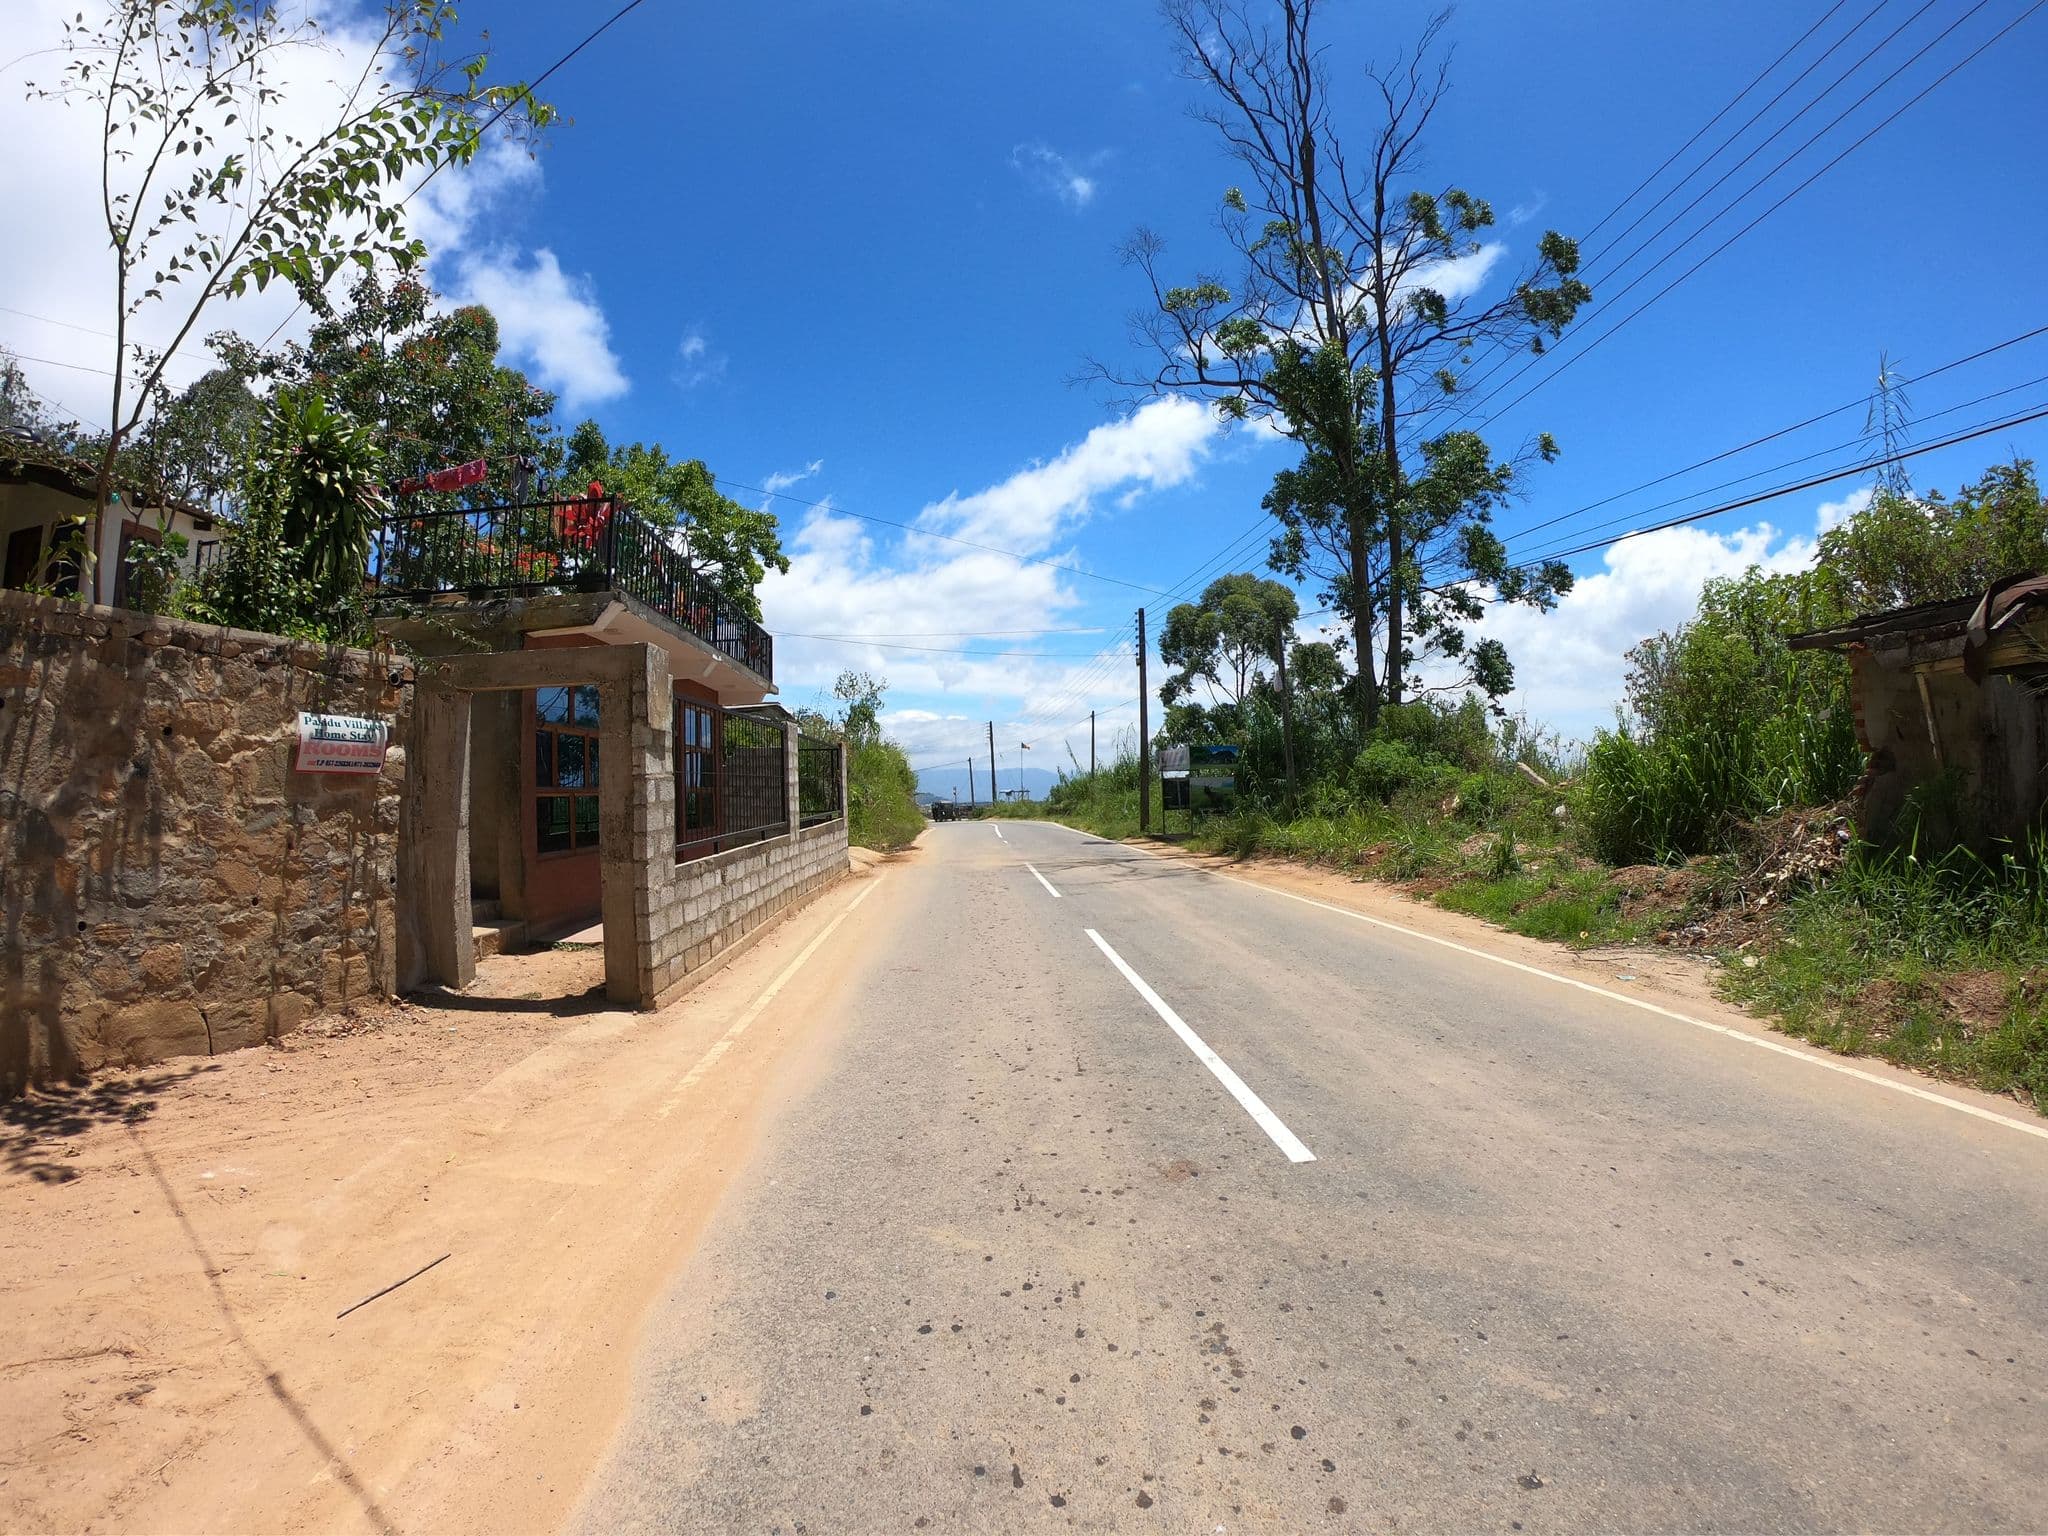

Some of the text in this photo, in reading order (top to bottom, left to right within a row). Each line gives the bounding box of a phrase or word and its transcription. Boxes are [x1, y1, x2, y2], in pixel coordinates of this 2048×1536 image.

[314, 728, 374, 742] Home Stay
[304, 742, 382, 758] ROOMS
